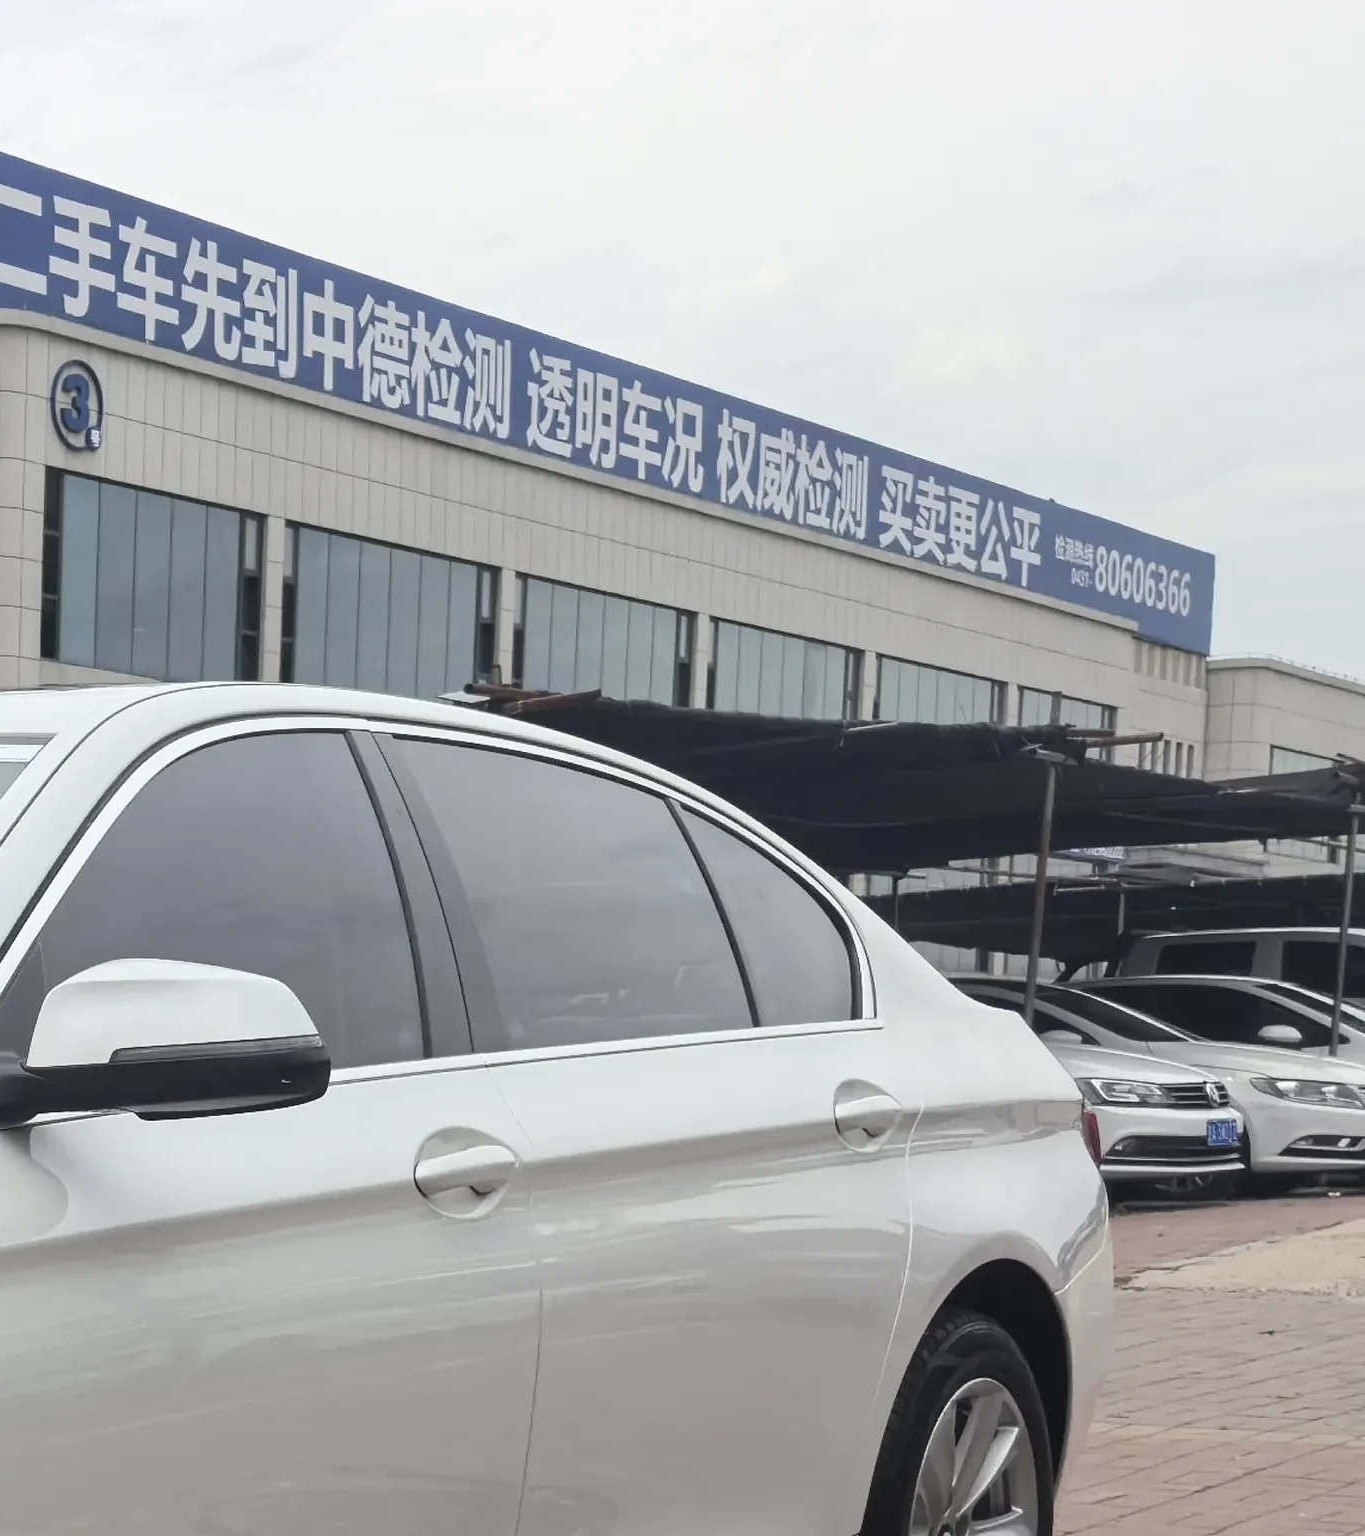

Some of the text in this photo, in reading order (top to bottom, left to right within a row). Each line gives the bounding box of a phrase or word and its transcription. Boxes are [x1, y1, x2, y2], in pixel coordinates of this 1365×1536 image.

[525, 347, 705, 494] 透明车况
[716, 408, 870, 541] 权威检测
[877, 465, 1042, 588] 买卖更公平
[1094, 545, 1191, 618] 80606366
